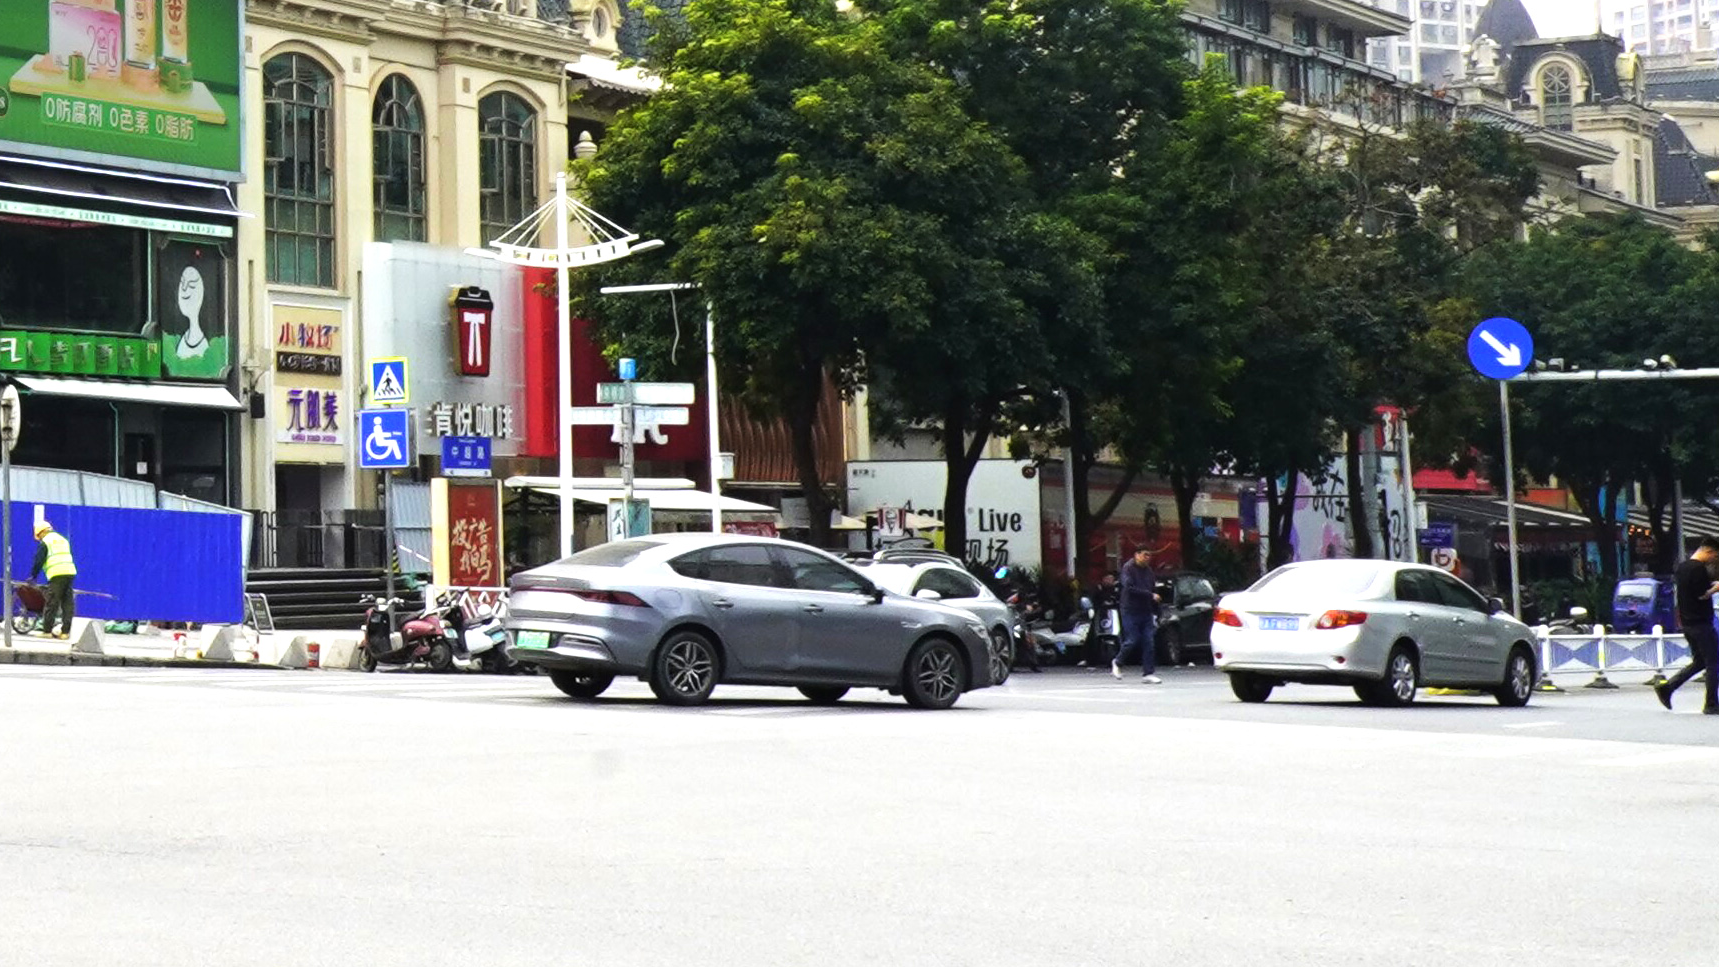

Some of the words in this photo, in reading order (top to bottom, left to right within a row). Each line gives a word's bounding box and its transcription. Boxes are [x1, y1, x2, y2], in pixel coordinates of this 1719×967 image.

[45, 97, 103, 128] 0防腐剂
[109, 107, 149, 135] 0色素
[286, 389, 339, 431] 元肌美
[434, 401, 513, 439] 肯悦咖啡
[979, 507, 1022, 533] Live
